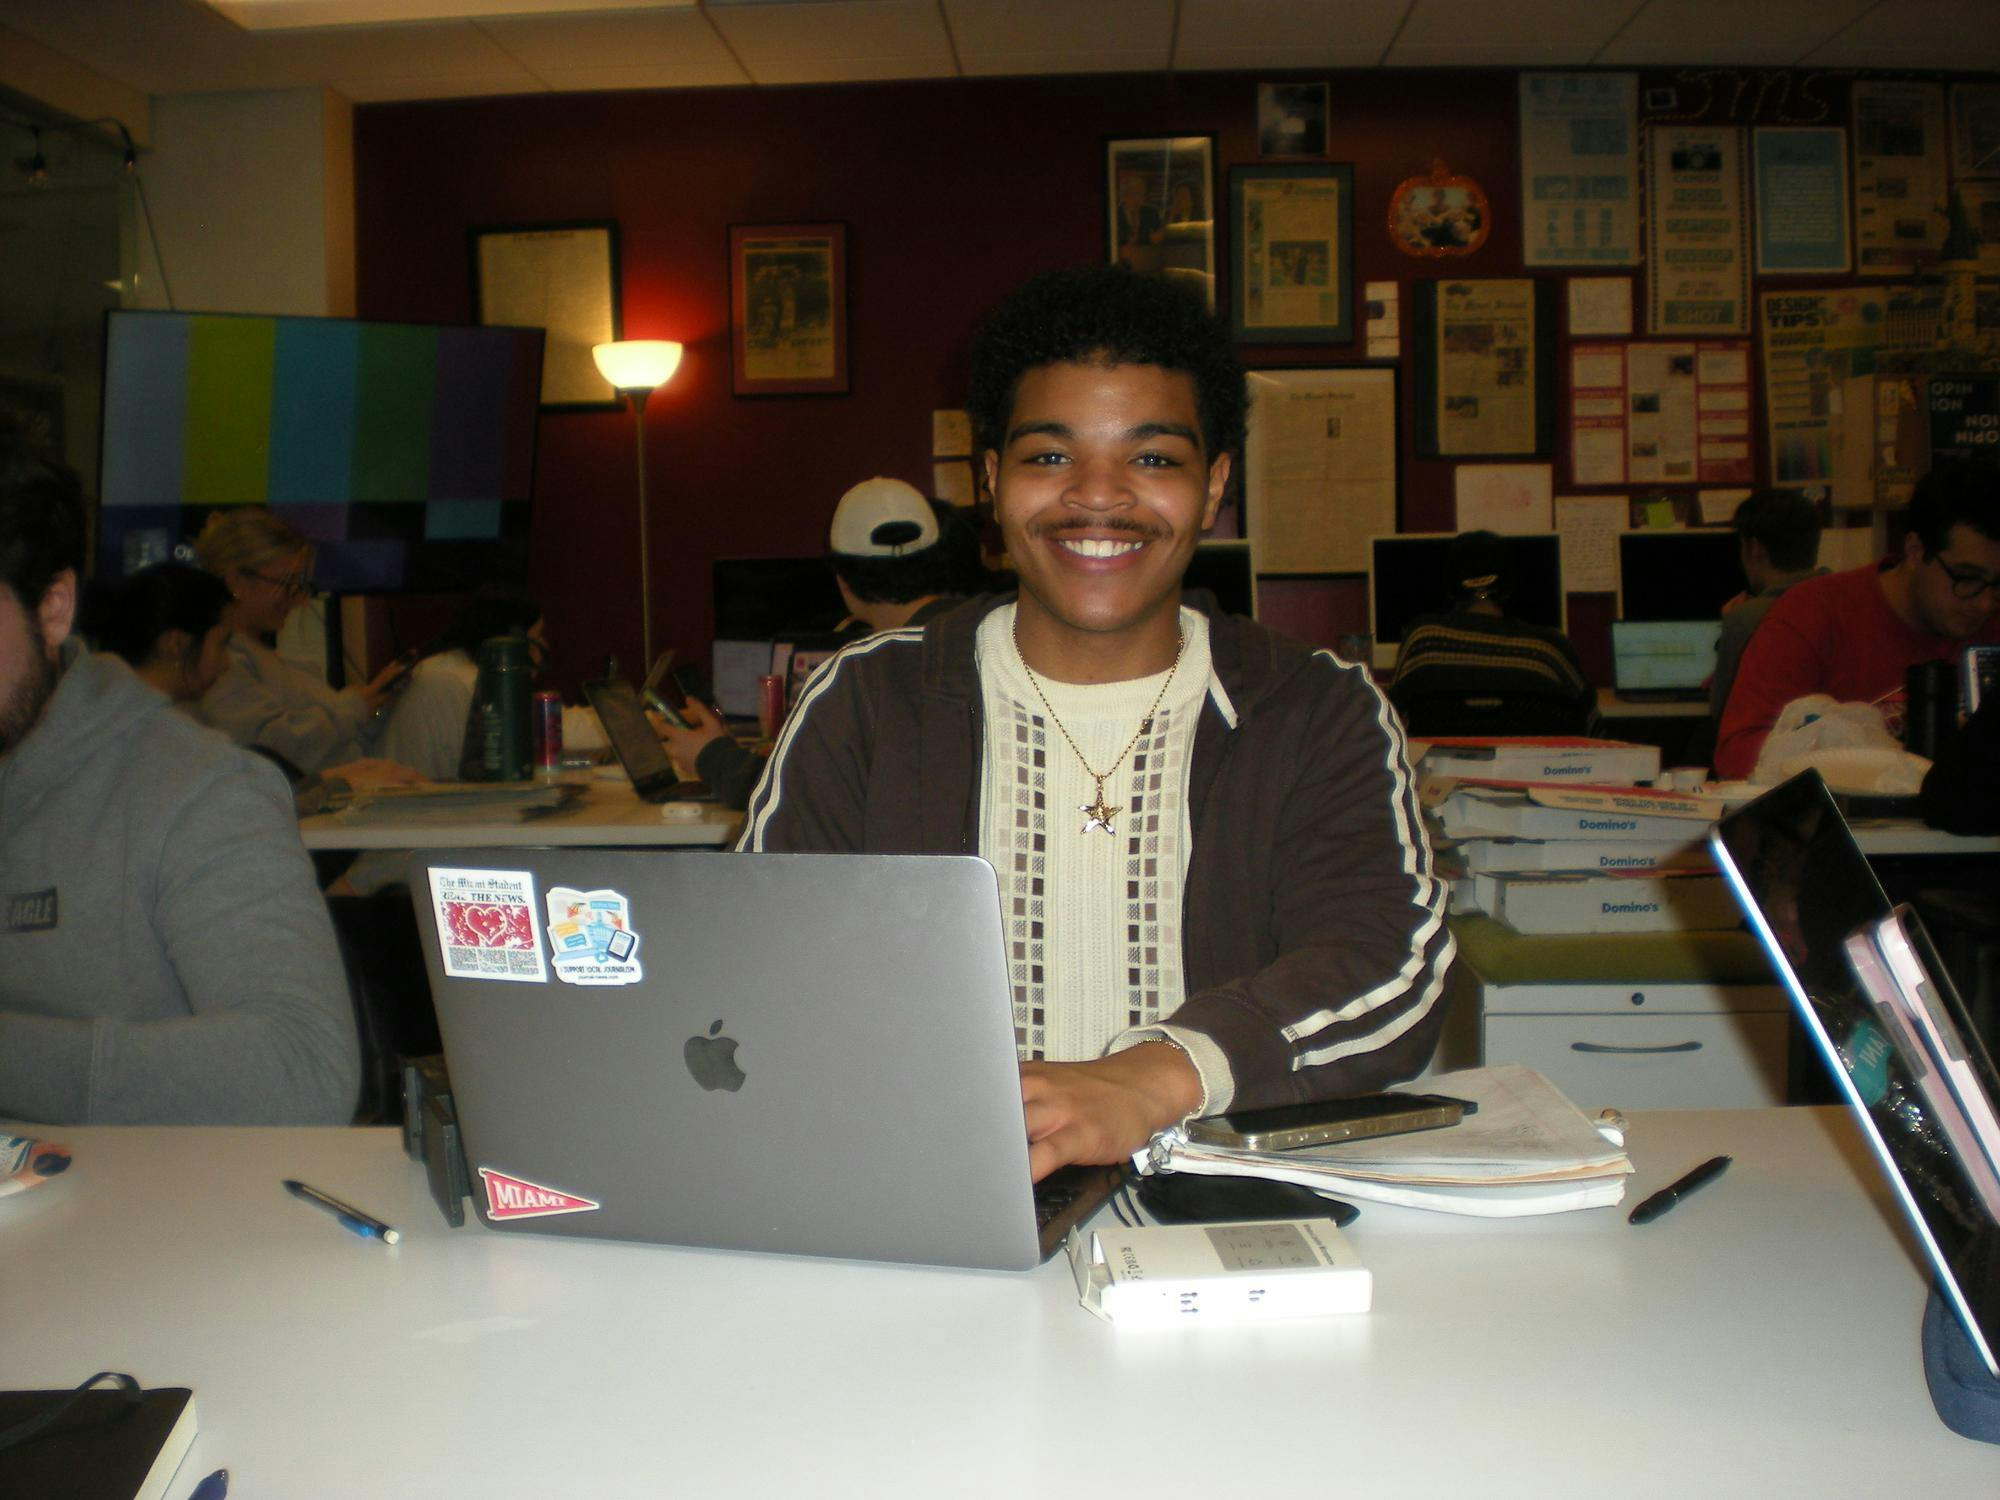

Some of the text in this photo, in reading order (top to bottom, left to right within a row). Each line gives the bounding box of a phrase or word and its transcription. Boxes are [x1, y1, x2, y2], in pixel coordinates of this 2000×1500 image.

[1768, 313, 1821, 327] TIPS
[1543, 765, 1592, 776] Domino's
[1579, 819, 1637, 830] Domino's
[1599, 855, 1656, 867] Domino's
[440, 876, 523, 891] The Miami Student
[471, 893, 492, 902] THE
[1602, 902, 1659, 914] Domino's
[493, 1180, 566, 1209] MIAMI
